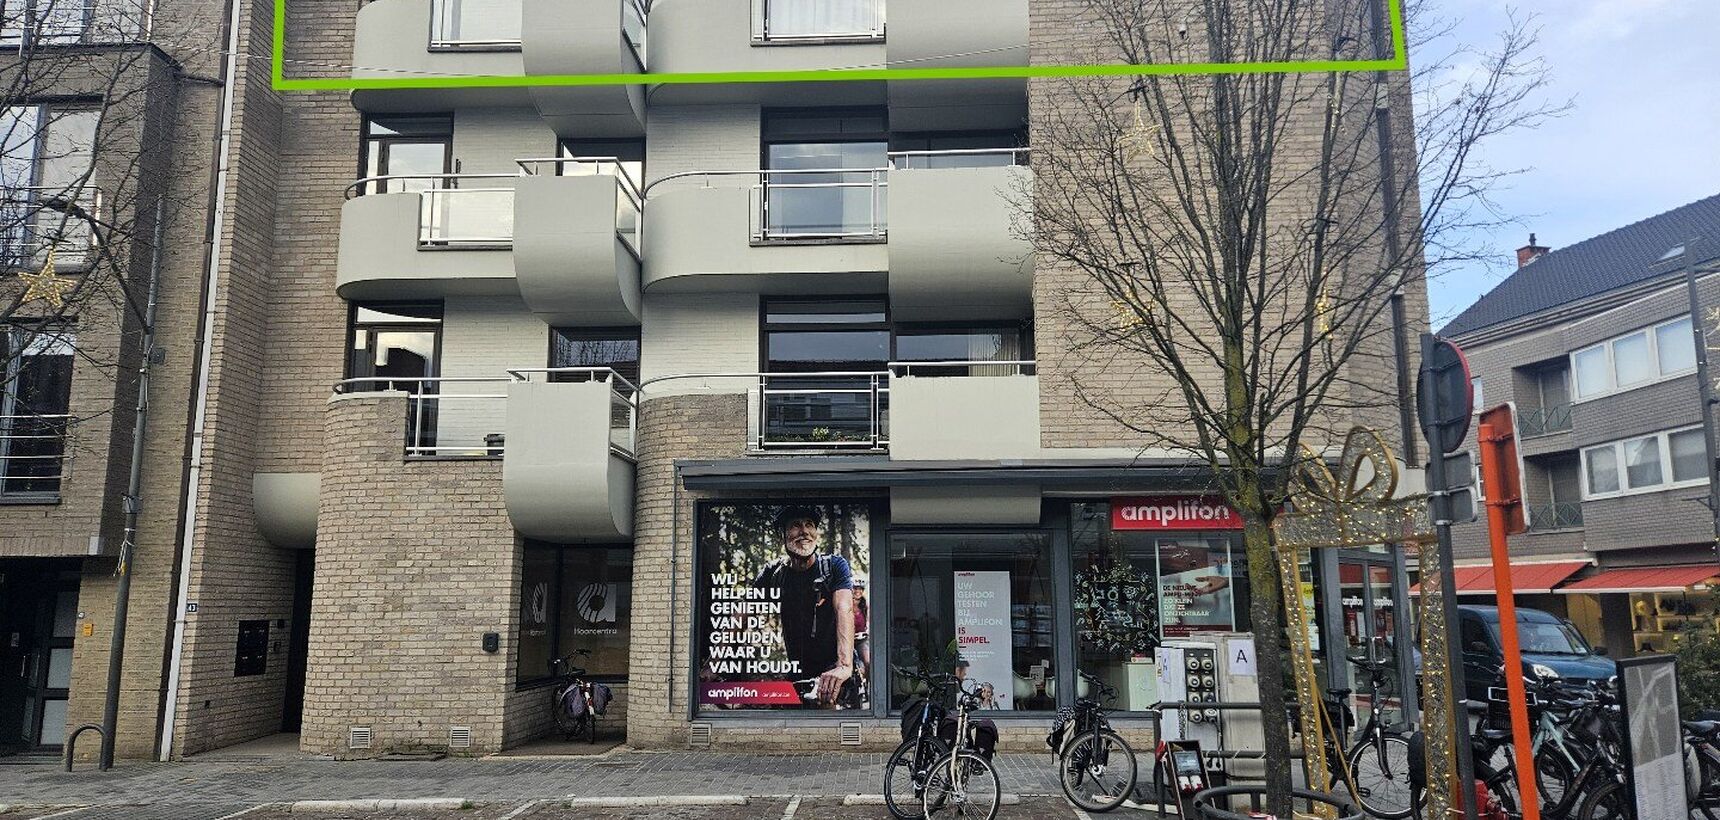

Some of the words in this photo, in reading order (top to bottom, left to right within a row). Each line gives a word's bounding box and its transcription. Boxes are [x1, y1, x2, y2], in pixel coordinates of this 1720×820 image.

[1121, 499, 1229, 526] amplifon
[711, 573, 738, 585] WIJ
[711, 587, 765, 600] HELPEN
[770, 587, 781, 600] U
[957, 591, 995, 600] GEHOOR
[710, 601, 781, 615] GENIETEN
[957, 600, 988, 608] TESTEN
[710, 616, 742, 629] VAN
[747, 616, 766, 629] DE
[958, 618, 1003, 626] AMPLIFON
[709, 631, 781, 644] GELUIDEN
[958, 627, 966, 635] IS
[958, 636, 990, 644] SIMPEL.
[709, 646, 755, 659] WAAR
[760, 646, 771, 659] U
[1236, 650, 1248, 663] A
[709, 660, 742, 674] VAN
[746, 660, 802, 674] HOUDT.
[708, 686, 758, 700] amplifon
